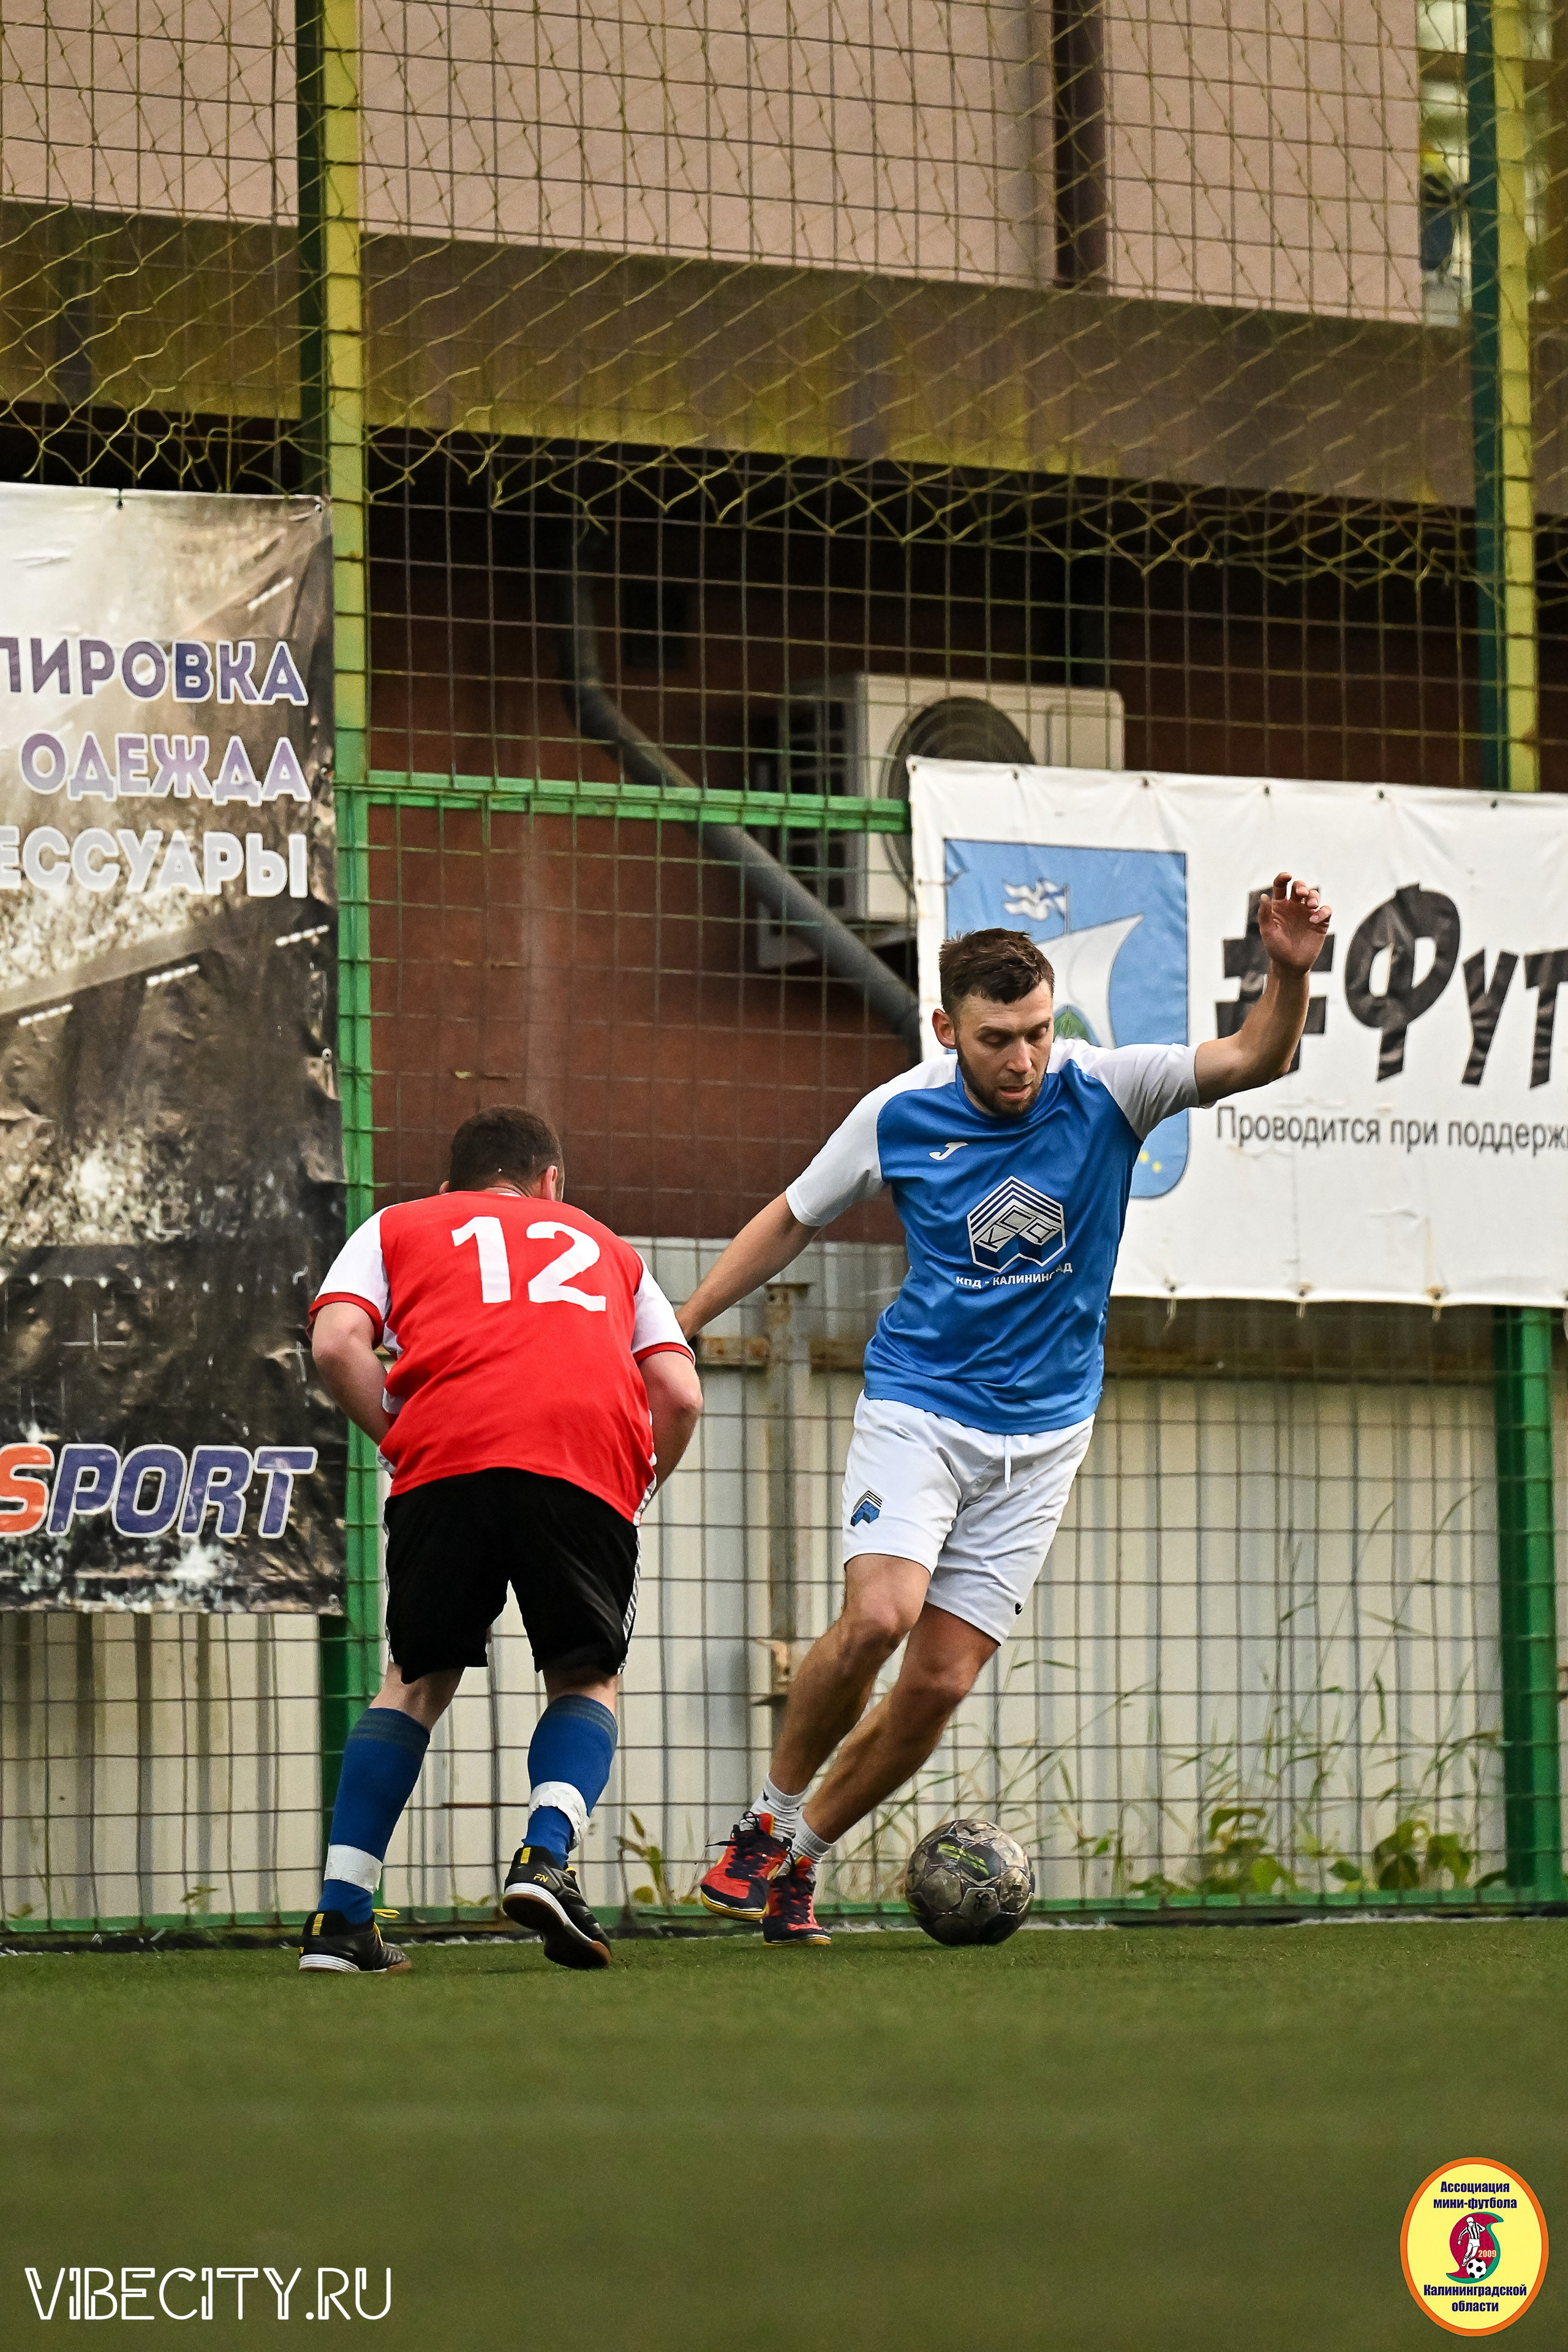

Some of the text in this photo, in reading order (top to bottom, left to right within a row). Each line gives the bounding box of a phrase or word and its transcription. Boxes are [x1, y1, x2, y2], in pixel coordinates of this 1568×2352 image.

[19, 731, 311, 807] ОДЕЖДА
[0, 825, 308, 898] ЕССУАРЫ
[1216, 1106, 1568, 1158] Проводится при поддерж
[451, 1216, 606, 1311] 12
[956, 1276, 982, 1289] КПД
[992, 1262, 1073, 1286] КАЛИНИНГАД
[0, 1442, 318, 1538] SPORT
